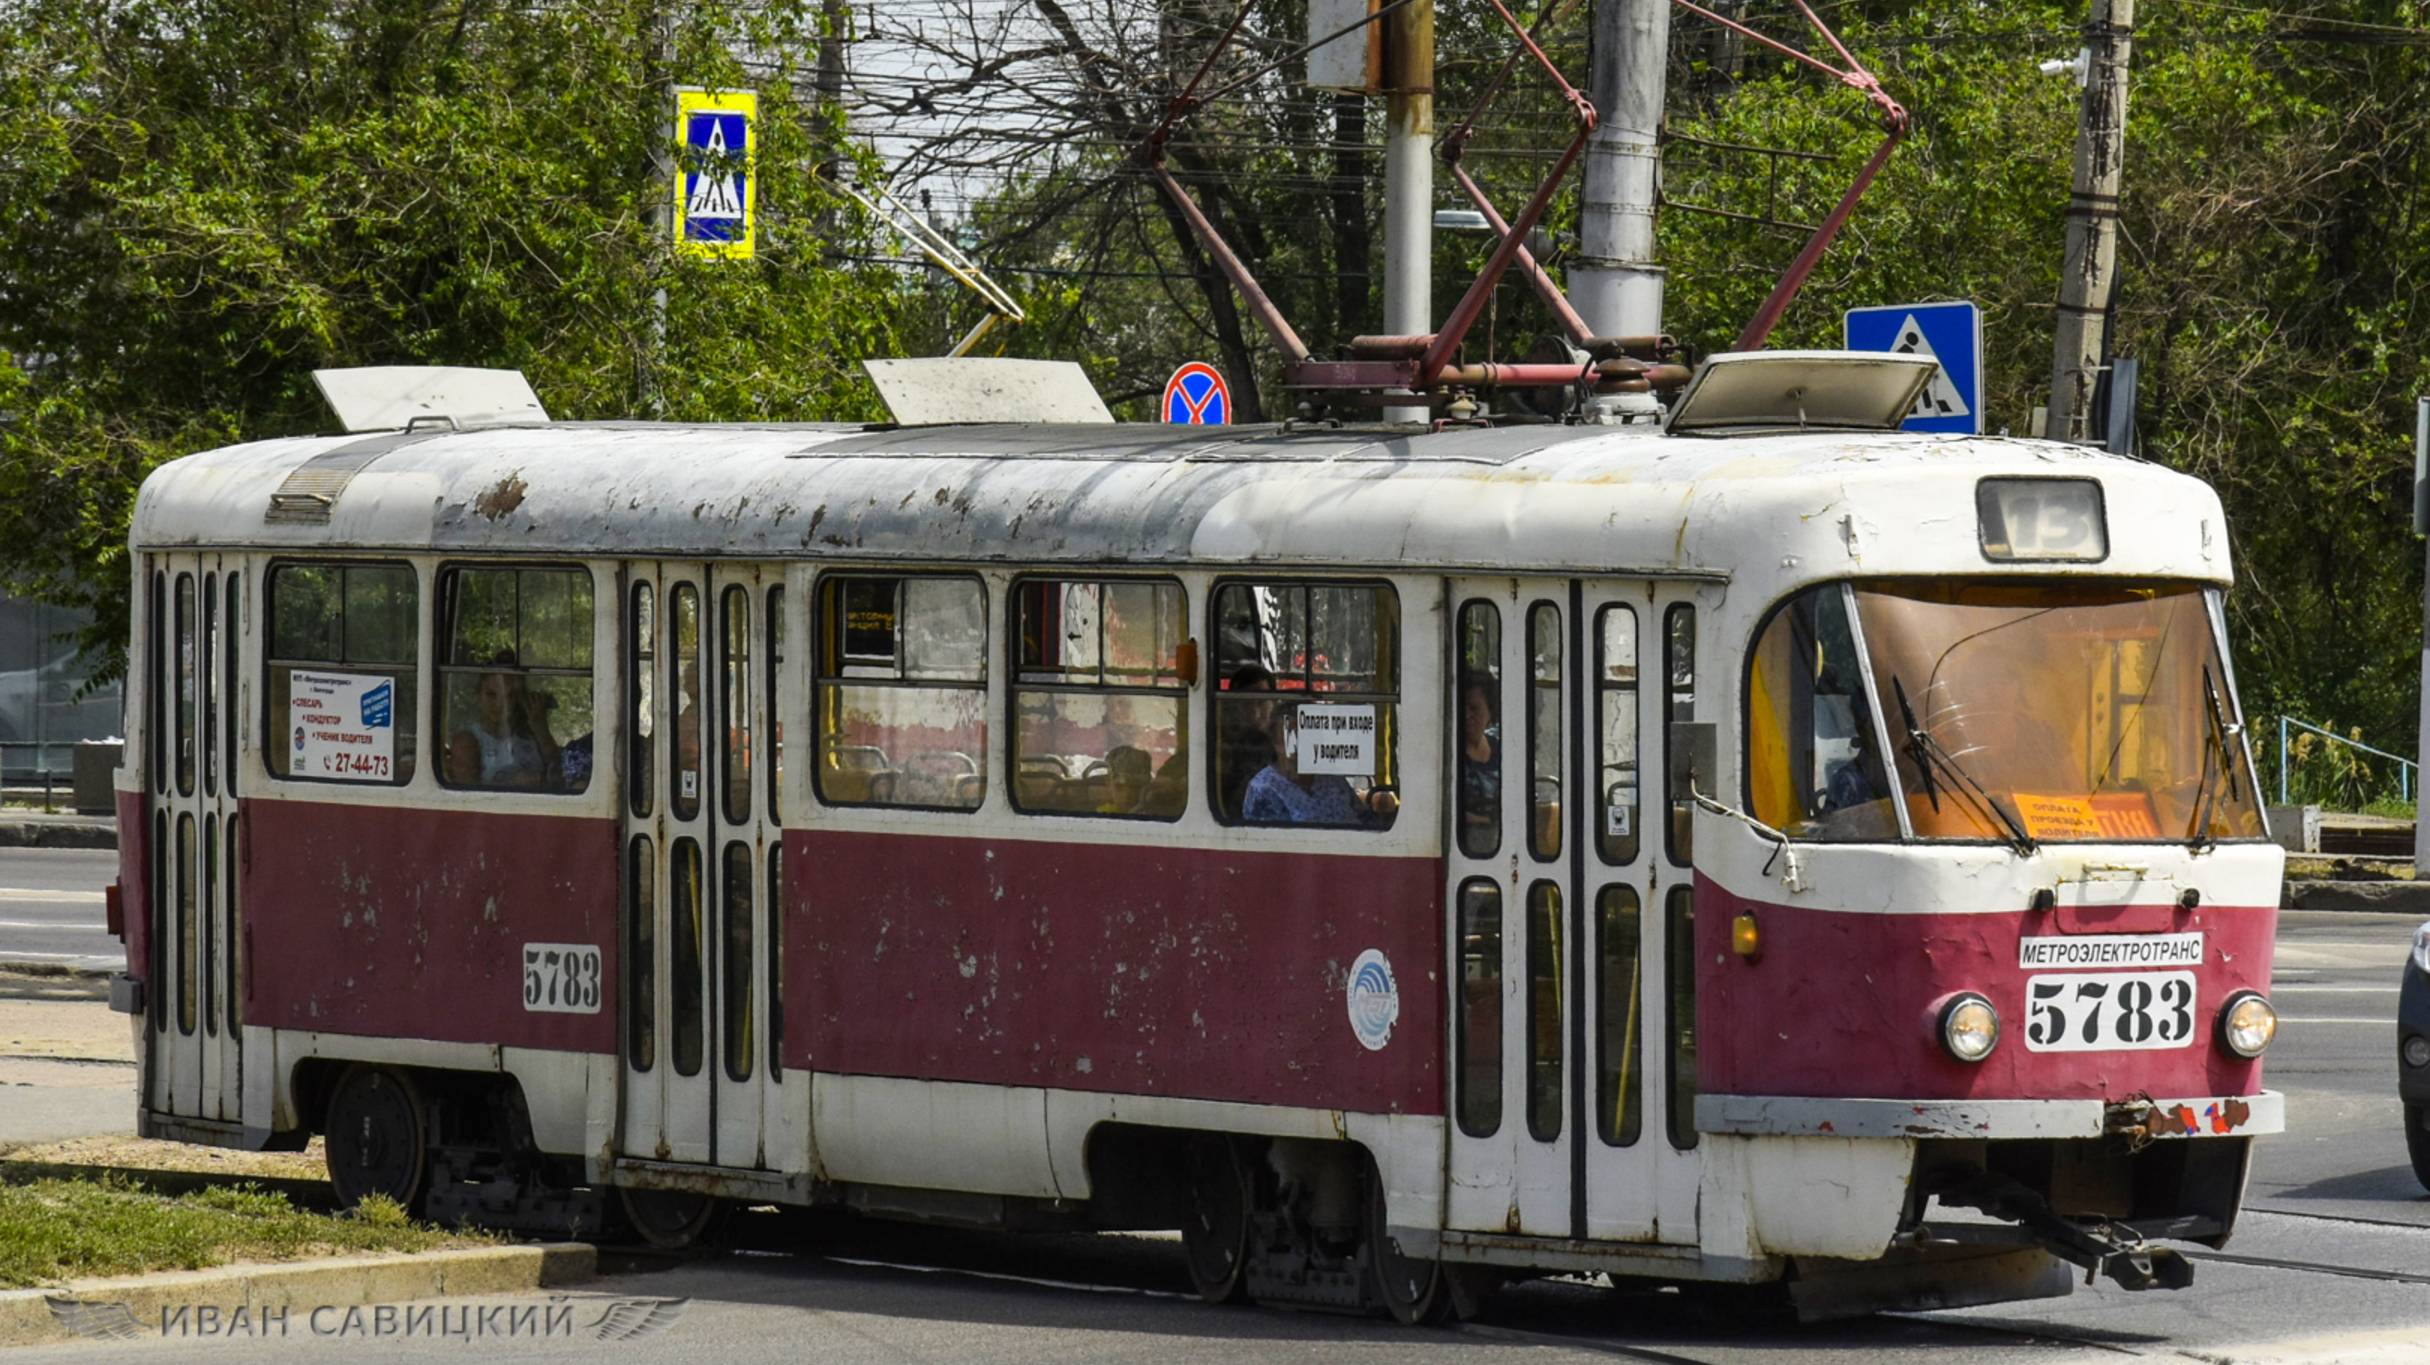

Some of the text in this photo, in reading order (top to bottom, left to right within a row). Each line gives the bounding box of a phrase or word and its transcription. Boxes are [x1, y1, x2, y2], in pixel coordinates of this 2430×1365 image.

[297, 697, 322, 708] СЛЕСАРЬ
[306, 713, 341, 724] КОНДУКТОР
[1299, 710, 1373, 735] Оплата при входе
[316, 731, 373, 745] УЧЕНИК ВОДИТЕЛЯ
[335, 752, 388, 776] 27-44-73
[1313, 743, 1359, 765] у водителя
[2031, 802, 2081, 814] ОПЛАТА
[2030, 814, 2094, 827] ПРОЕЗДА У
[2022, 939, 2201, 963] МЕТРОЭЛЕКТРОТРАНС
[525, 950, 599, 1008] 5783
[2028, 978, 2192, 1045] 5783
